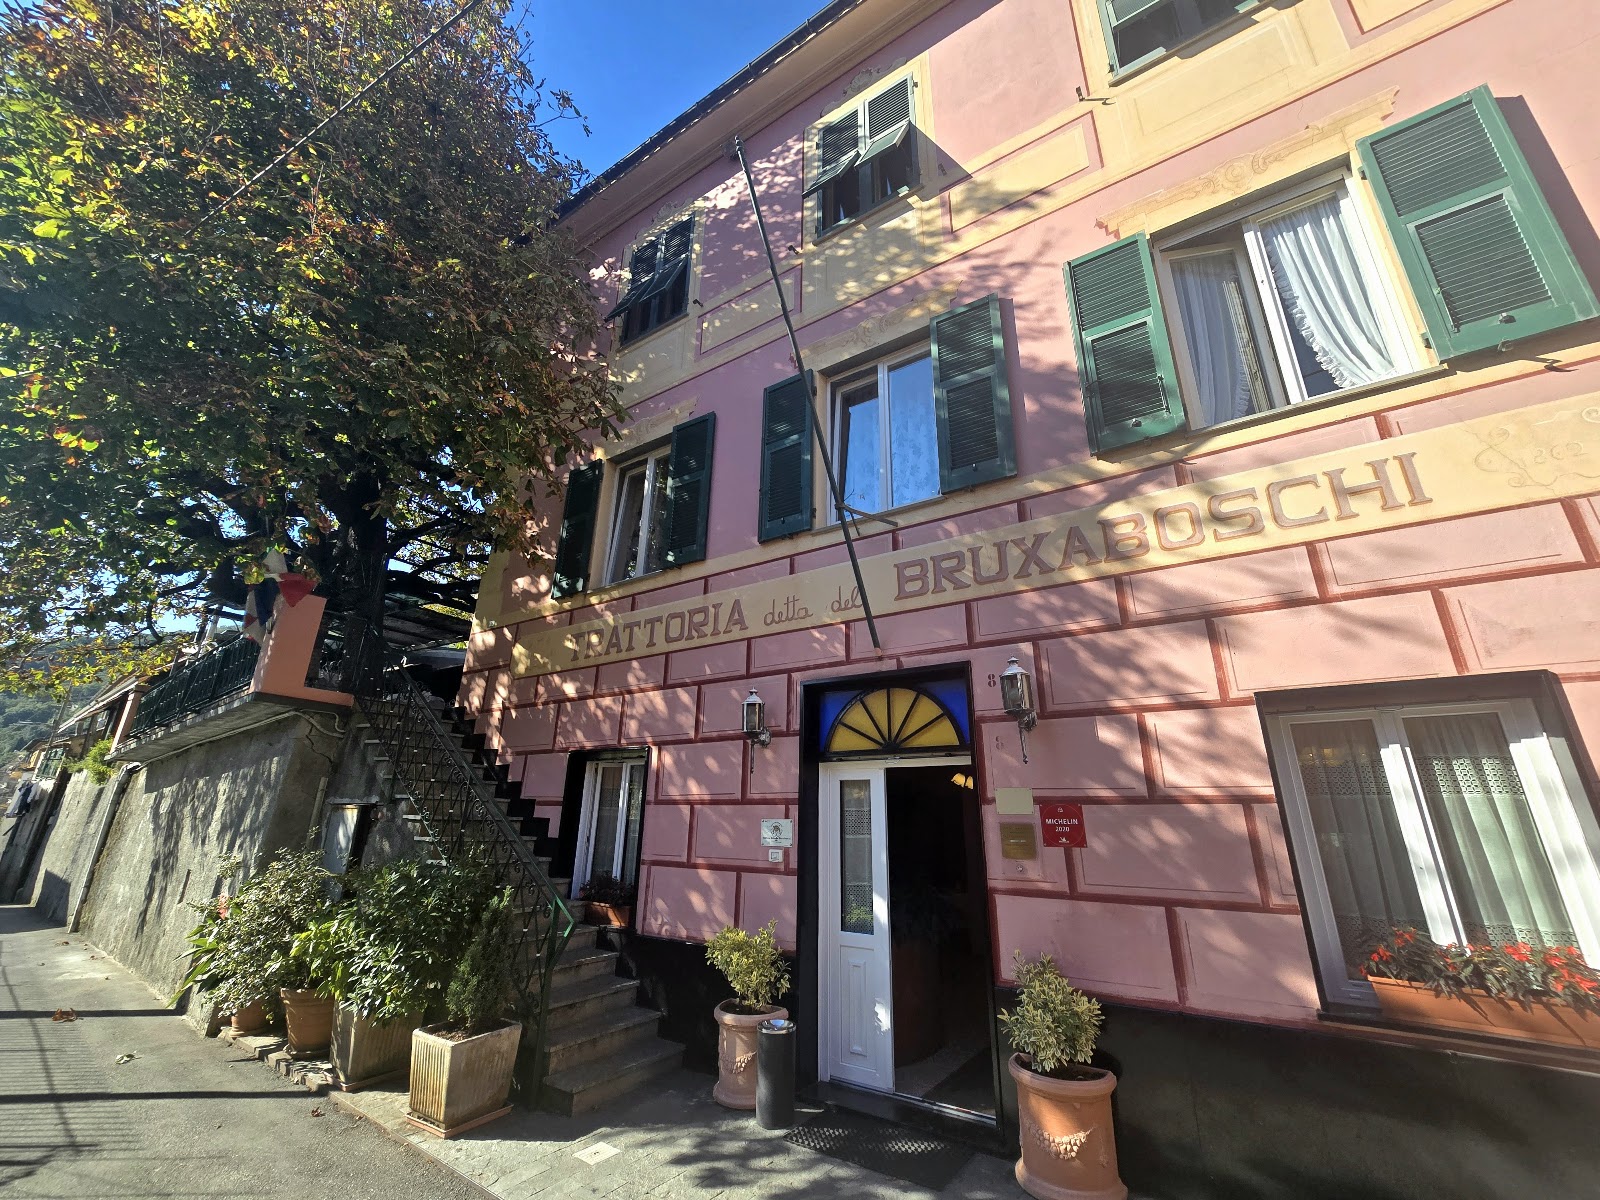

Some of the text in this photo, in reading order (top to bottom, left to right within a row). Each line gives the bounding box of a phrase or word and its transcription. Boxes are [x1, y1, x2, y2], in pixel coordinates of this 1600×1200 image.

[570, 451, 1434, 662] TRATTORIA detta del BRUXABOSCHI
[987, 673, 997, 688] 8
